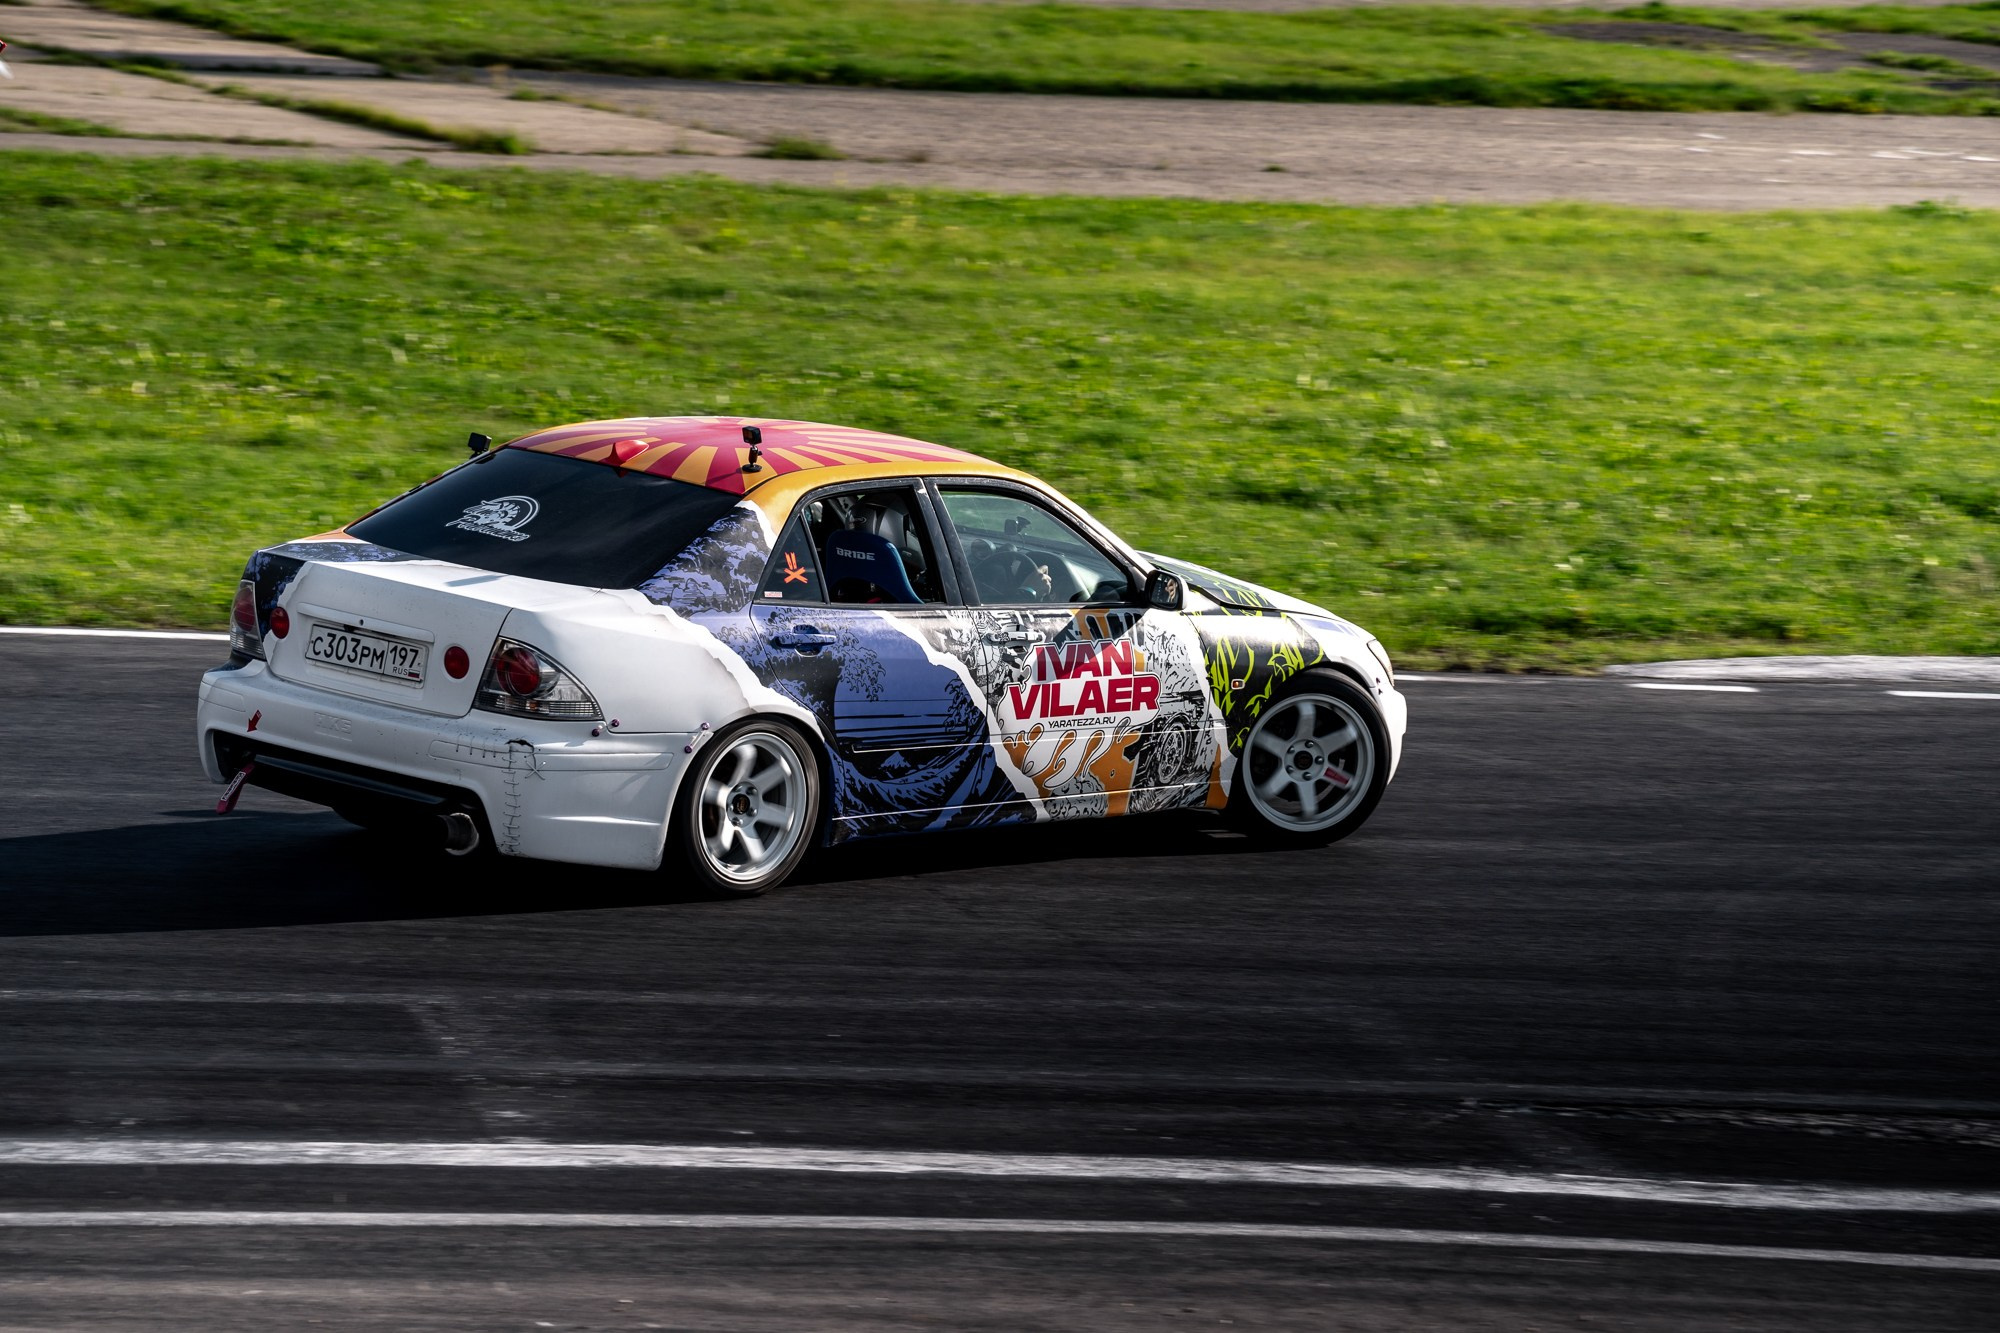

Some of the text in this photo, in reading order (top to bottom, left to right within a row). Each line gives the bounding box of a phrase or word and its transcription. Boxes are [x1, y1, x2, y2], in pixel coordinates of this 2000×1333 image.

[836, 547, 876, 561] BRIDE
[390, 646, 419, 668] 197
[1036, 641, 1132, 681] IVAN
[393, 667, 408, 676] RUS
[1009, 676, 1160, 720] VILAER
[1048, 716, 1116, 729] YARATEZZA.RU
